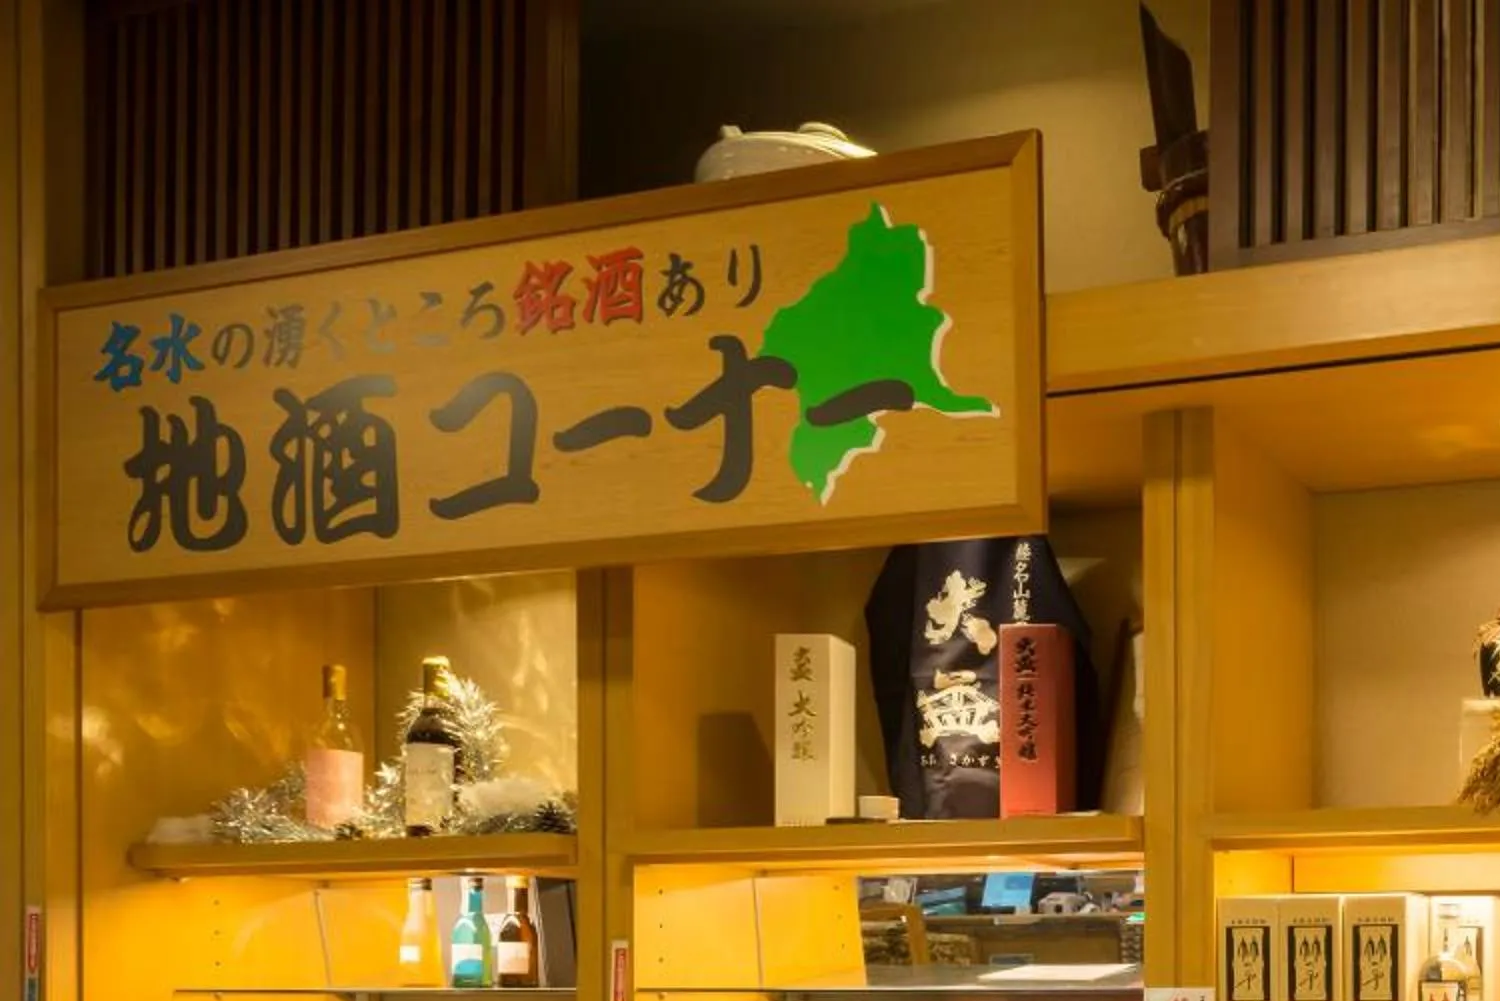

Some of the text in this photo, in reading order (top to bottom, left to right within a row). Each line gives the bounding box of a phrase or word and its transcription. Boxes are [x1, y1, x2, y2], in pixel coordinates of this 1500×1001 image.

[92, 245, 764, 392] 名水の湧くところ銘酒あり
[122, 334, 917, 553] 地酒コーナー
